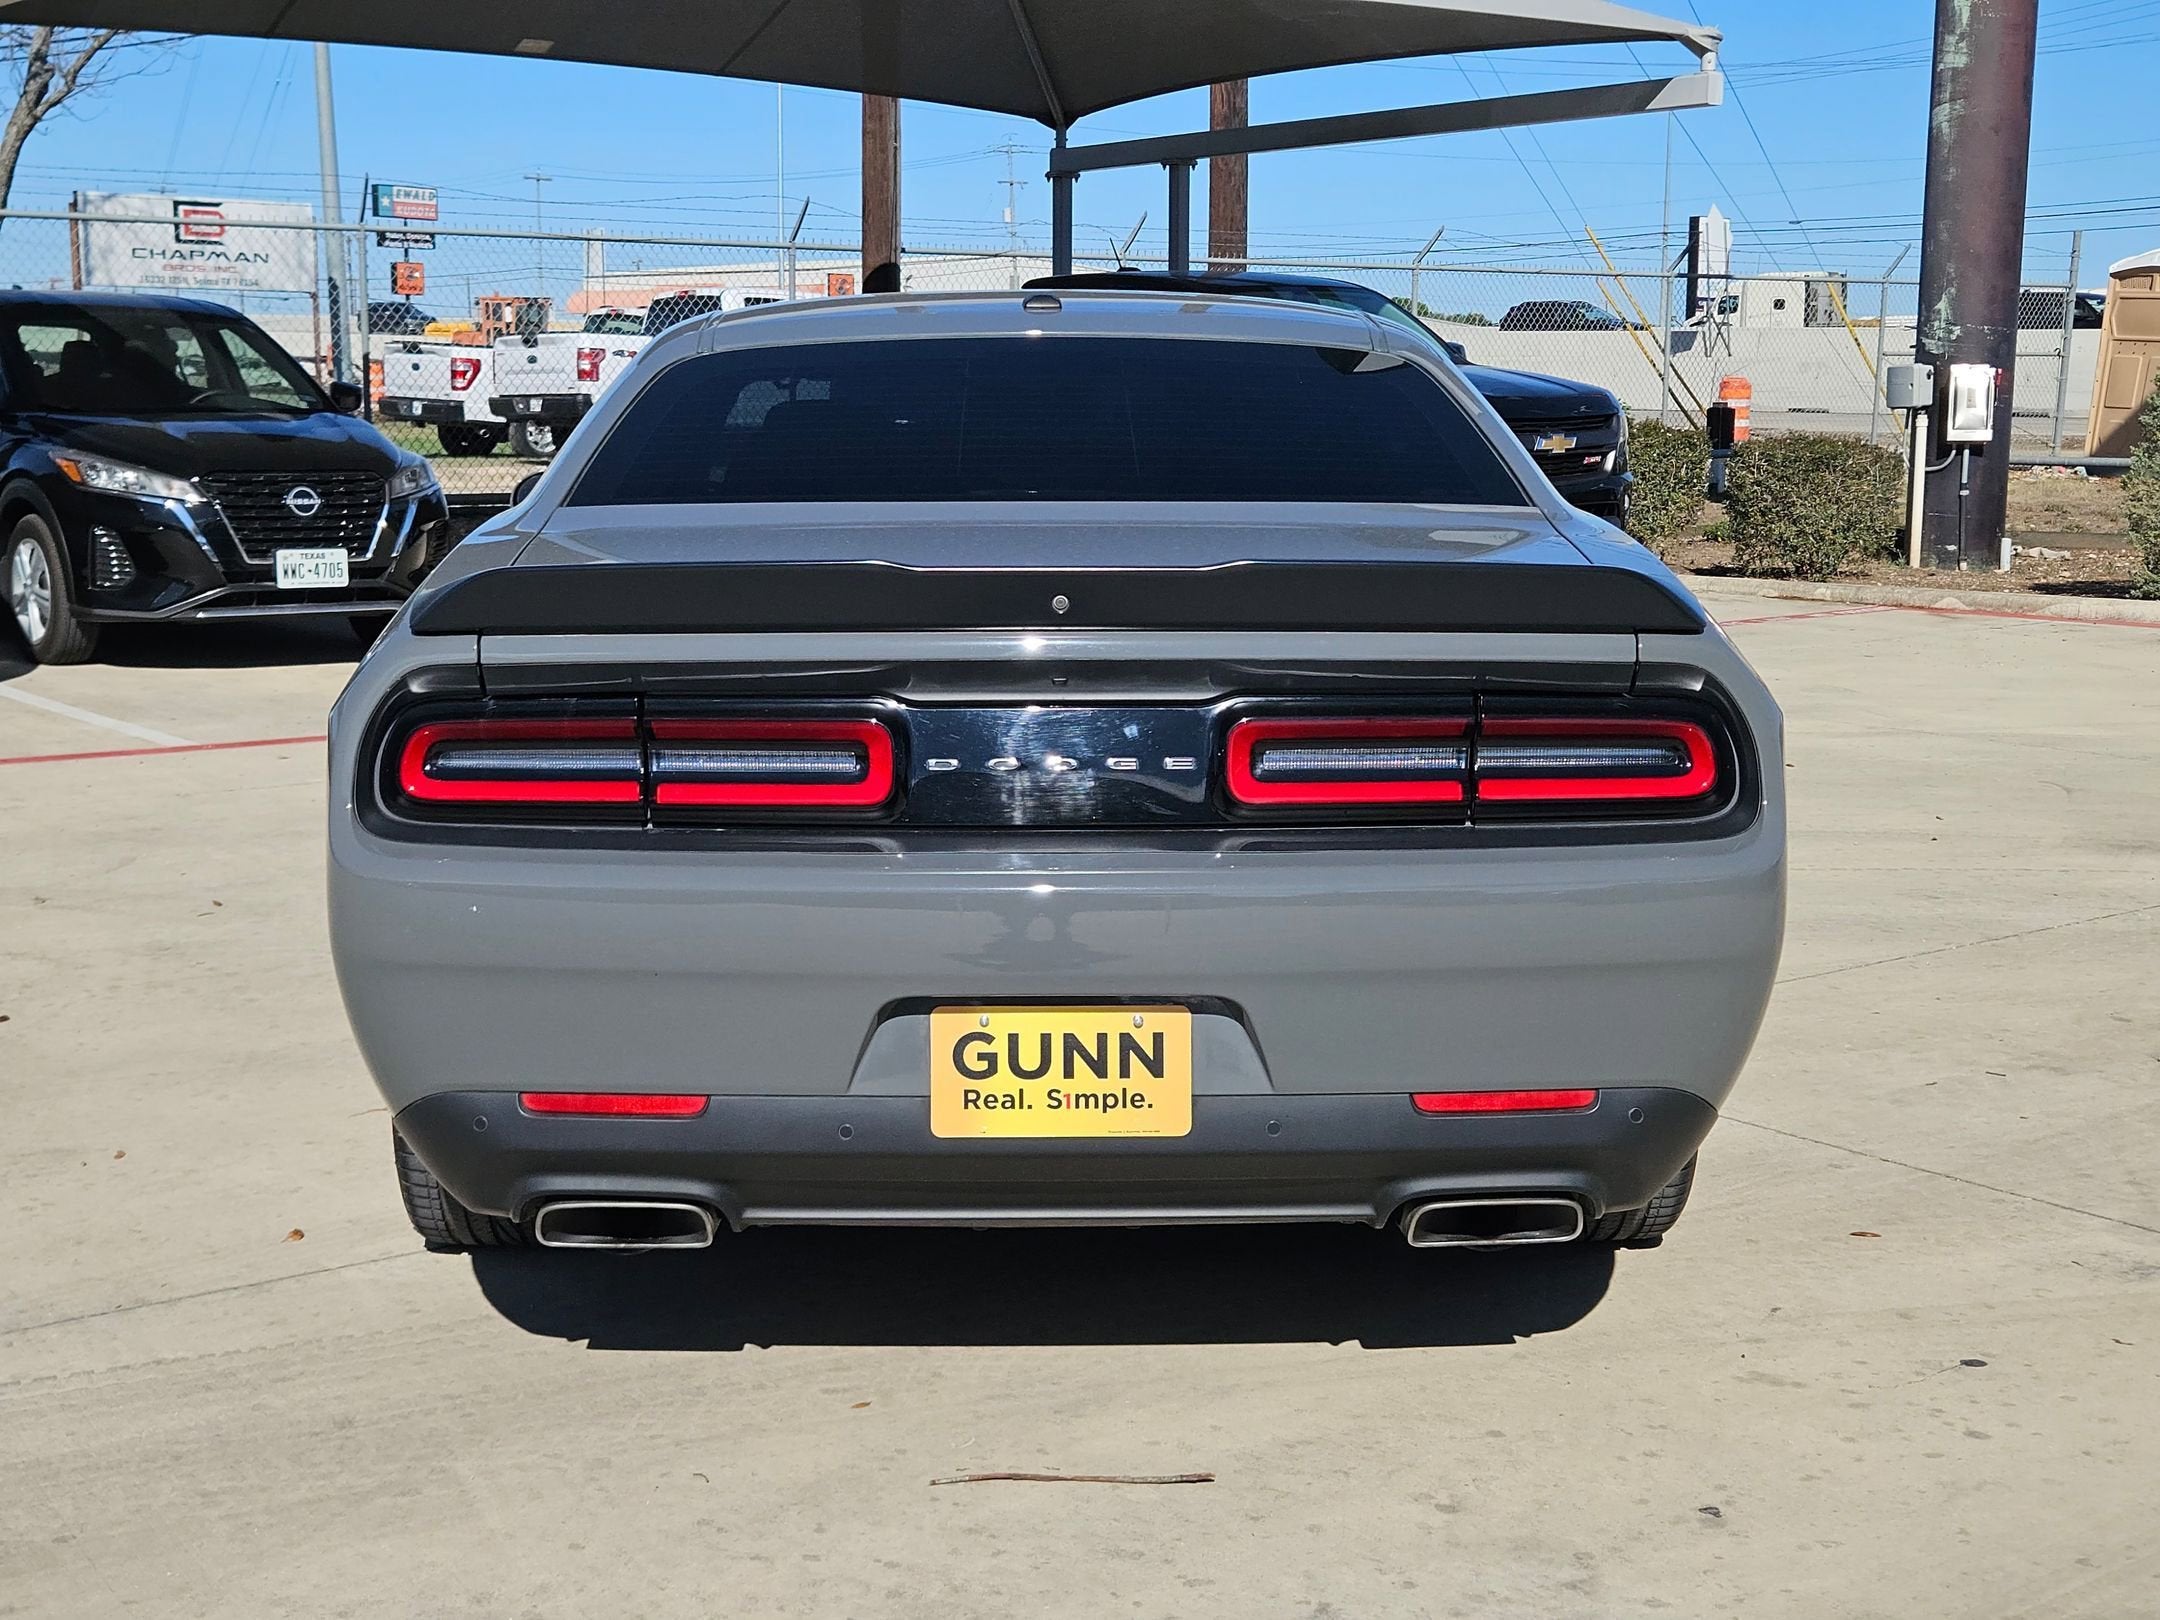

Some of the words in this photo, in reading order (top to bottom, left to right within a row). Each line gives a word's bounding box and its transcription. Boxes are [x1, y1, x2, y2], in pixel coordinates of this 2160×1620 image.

[396, 189, 436, 201] EWALD
[131, 247, 269, 263] CHAPMAN
[300, 552, 326, 560] TEXAS
[925, 756, 1197, 772] DODGE
[952, 1031, 1165, 1081] GUNN
[963, 1088, 1033, 1110] Real.
